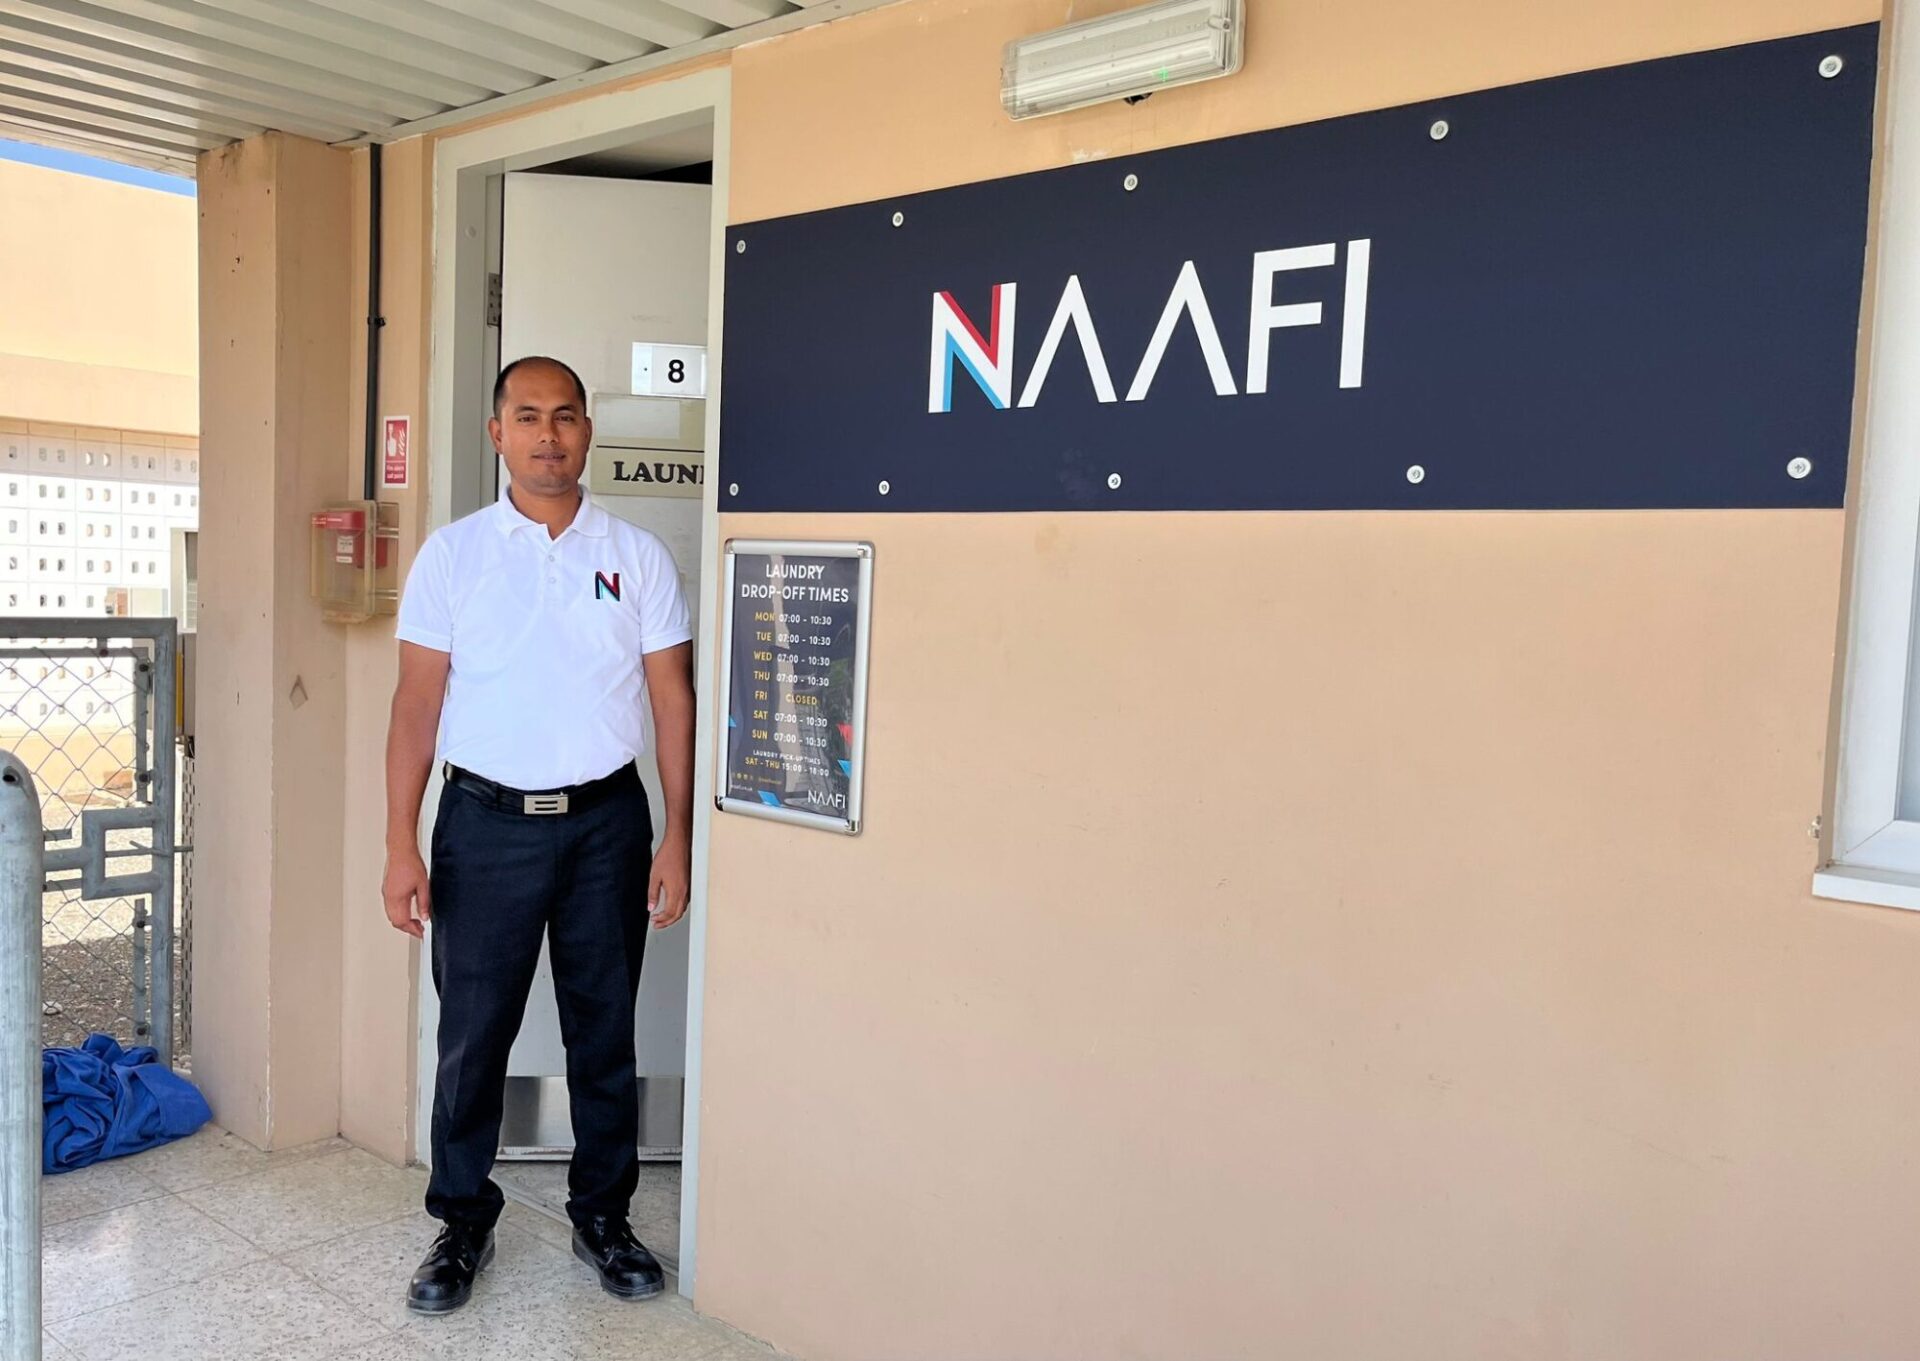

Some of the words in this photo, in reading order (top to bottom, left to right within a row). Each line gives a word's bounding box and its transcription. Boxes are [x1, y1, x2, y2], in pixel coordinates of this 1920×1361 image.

[928, 238, 1371, 413] NAAFI
[668, 359, 685, 383] 8
[613, 461, 704, 485] LAUN
[766, 564, 825, 579] LAUNDRY
[595, 571, 620, 602] N
[741, 584, 805, 600] DROP-OFF
[808, 587, 849, 603] TIMES
[755, 612, 775, 621] MON
[779, 614, 800, 623] 07:00
[810, 616, 832, 625] 10:30
[756, 632, 772, 641] TUE
[778, 634, 800, 643] 07:00
[809, 636, 831, 646] 10:30
[753, 651, 773, 661] WED
[777, 653, 799, 663] 07:00
[808, 656, 831, 666] 10:30
[753, 671, 771, 681] THU
[776, 673, 798, 683] 07:00
[807, 676, 830, 686] 10:30
[754, 690, 768, 700] FRI
[785, 693, 818, 705] CLOSED
[753, 710, 769, 720] SAT
[774, 712, 797, 723] 07:00
[806, 716, 828, 727] 10:30
[751, 729, 768, 739] SUN
[773, 732, 797, 743] 07:00
[805, 736, 827, 747] 10:30
[745, 757, 758, 766] SAT
[765, 760, 780, 769] THU
[807, 790, 846, 809] NAAFI
